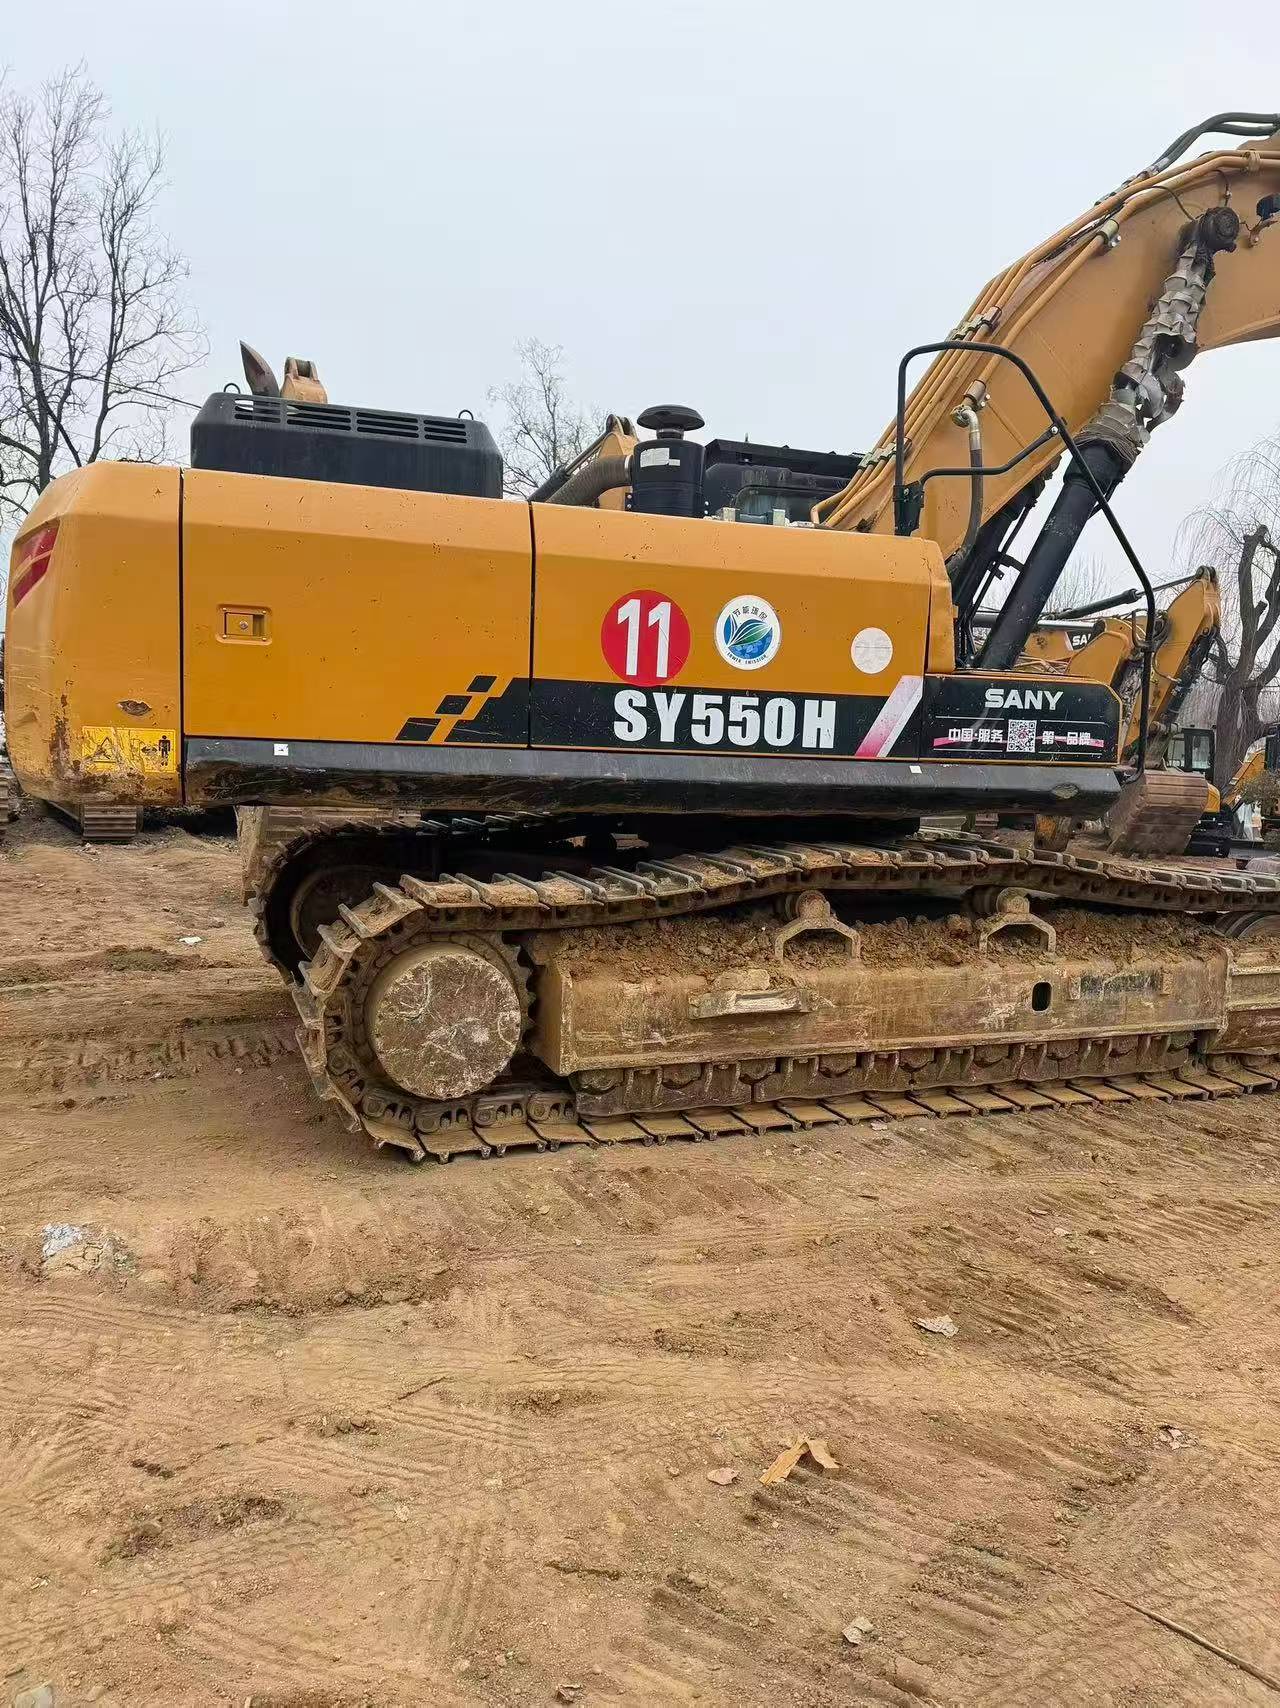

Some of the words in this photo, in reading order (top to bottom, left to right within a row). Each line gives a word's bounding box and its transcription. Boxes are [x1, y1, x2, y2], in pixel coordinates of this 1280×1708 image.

[617, 599, 671, 678] 11
[1072, 633, 1092, 647] SA
[984, 688, 1064, 711] SANY
[613, 689, 836, 749] SY550H
[1041, 730, 1091, 746] 第一品牌
